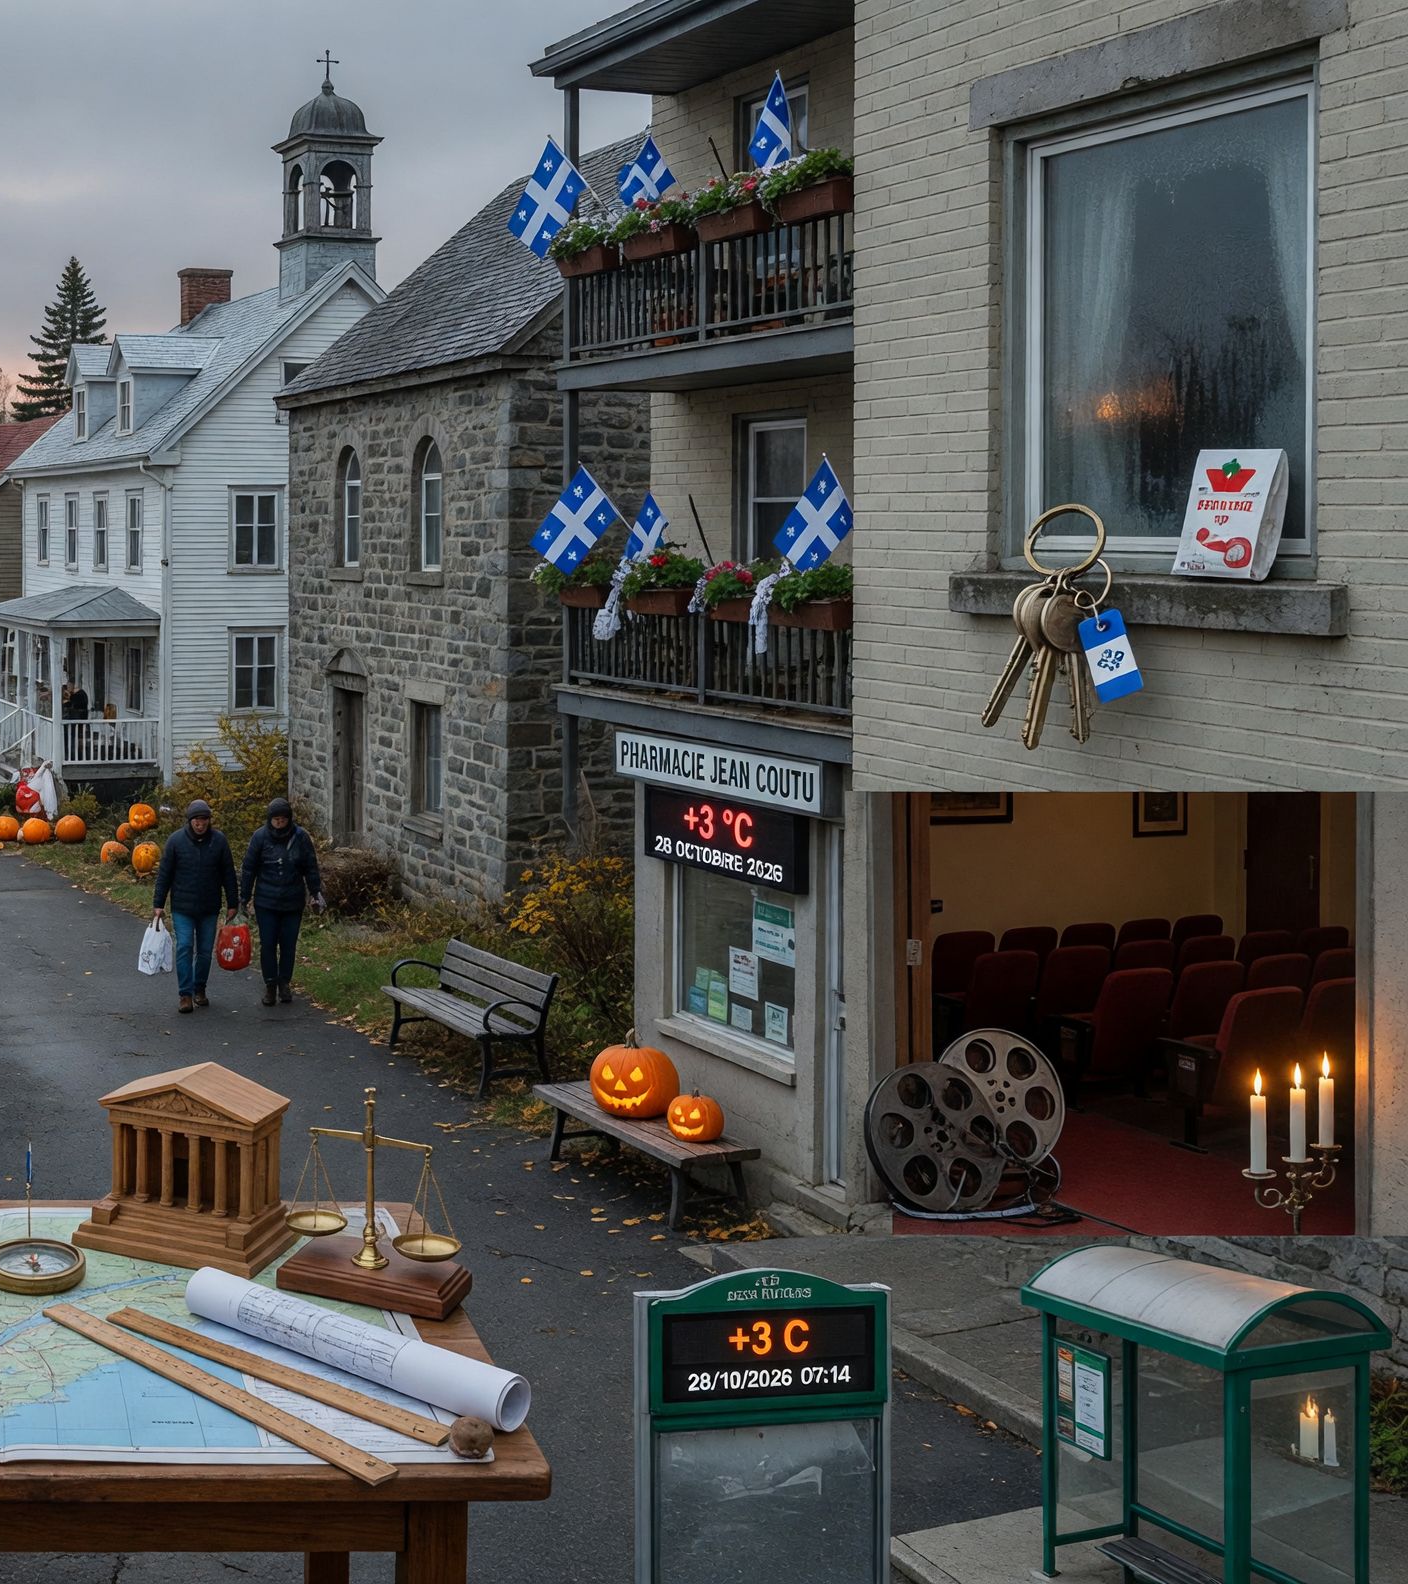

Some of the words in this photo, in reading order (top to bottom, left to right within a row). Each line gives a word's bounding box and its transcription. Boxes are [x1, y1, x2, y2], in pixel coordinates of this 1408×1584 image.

[621, 740, 705, 781] PHARMACIE
[710, 755, 750, 790] JEAN
[756, 763, 814, 803] COUTU
[683, 804, 714, 840] +3
[722, 808, 753, 848] °C
[746, 857, 783, 882] 2026
[728, 1320, 772, 1355] +3
[784, 1319, 809, 1353] C
[687, 1368, 793, 1392] 28/10/2026
[800, 1365, 851, 1385] 07:14
